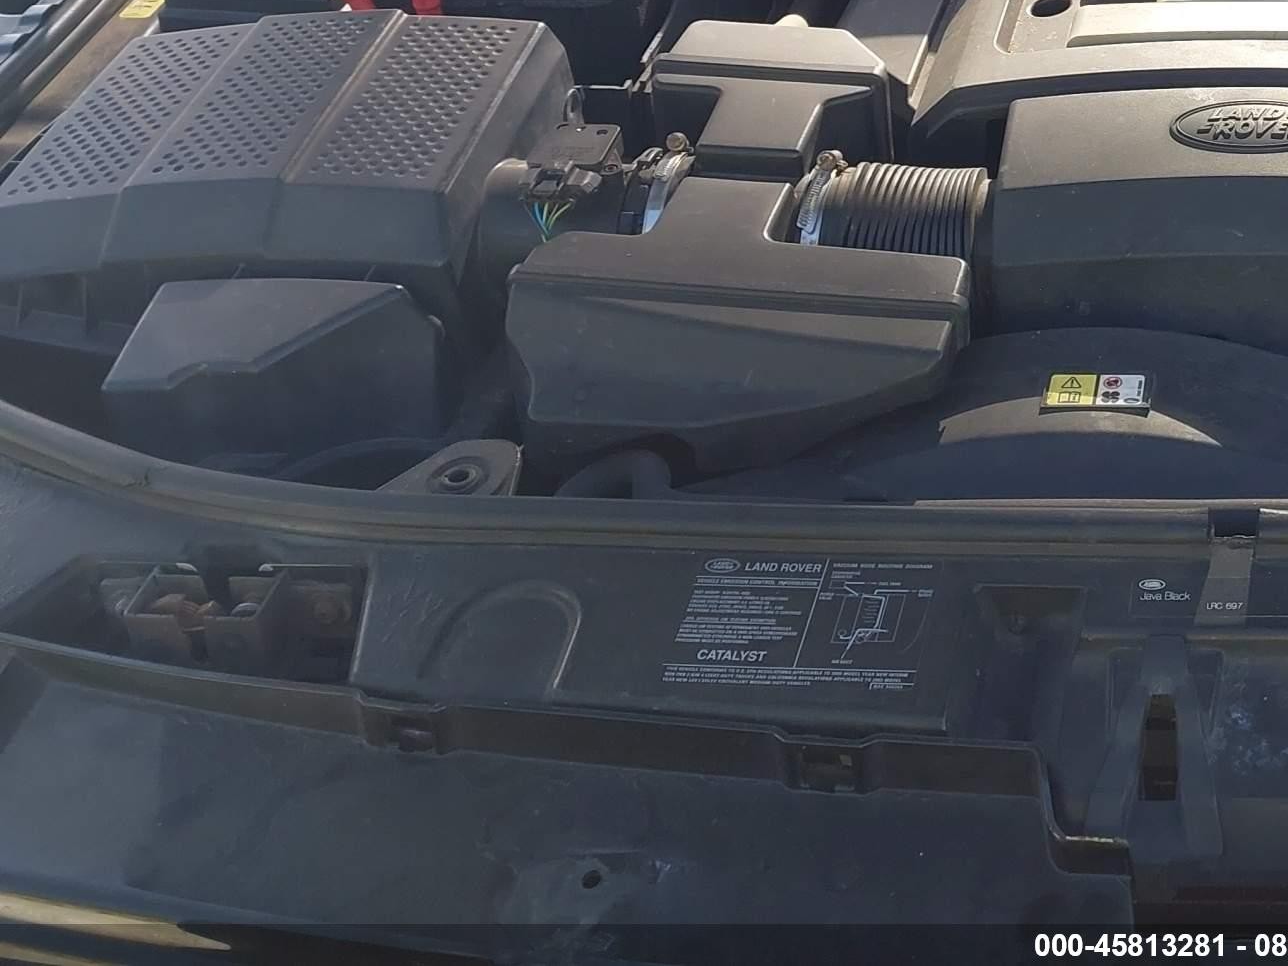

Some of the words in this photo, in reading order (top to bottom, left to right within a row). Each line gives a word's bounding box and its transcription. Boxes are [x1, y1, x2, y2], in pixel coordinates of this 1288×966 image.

[1207, 107, 1288, 122] LAND
[745, 562, 778, 572] LAND
[781, 563, 822, 573] ROVER
[1140, 592, 1162, 601] Java
[1165, 591, 1191, 601] Black
[697, 649, 767, 662] CATALYST
